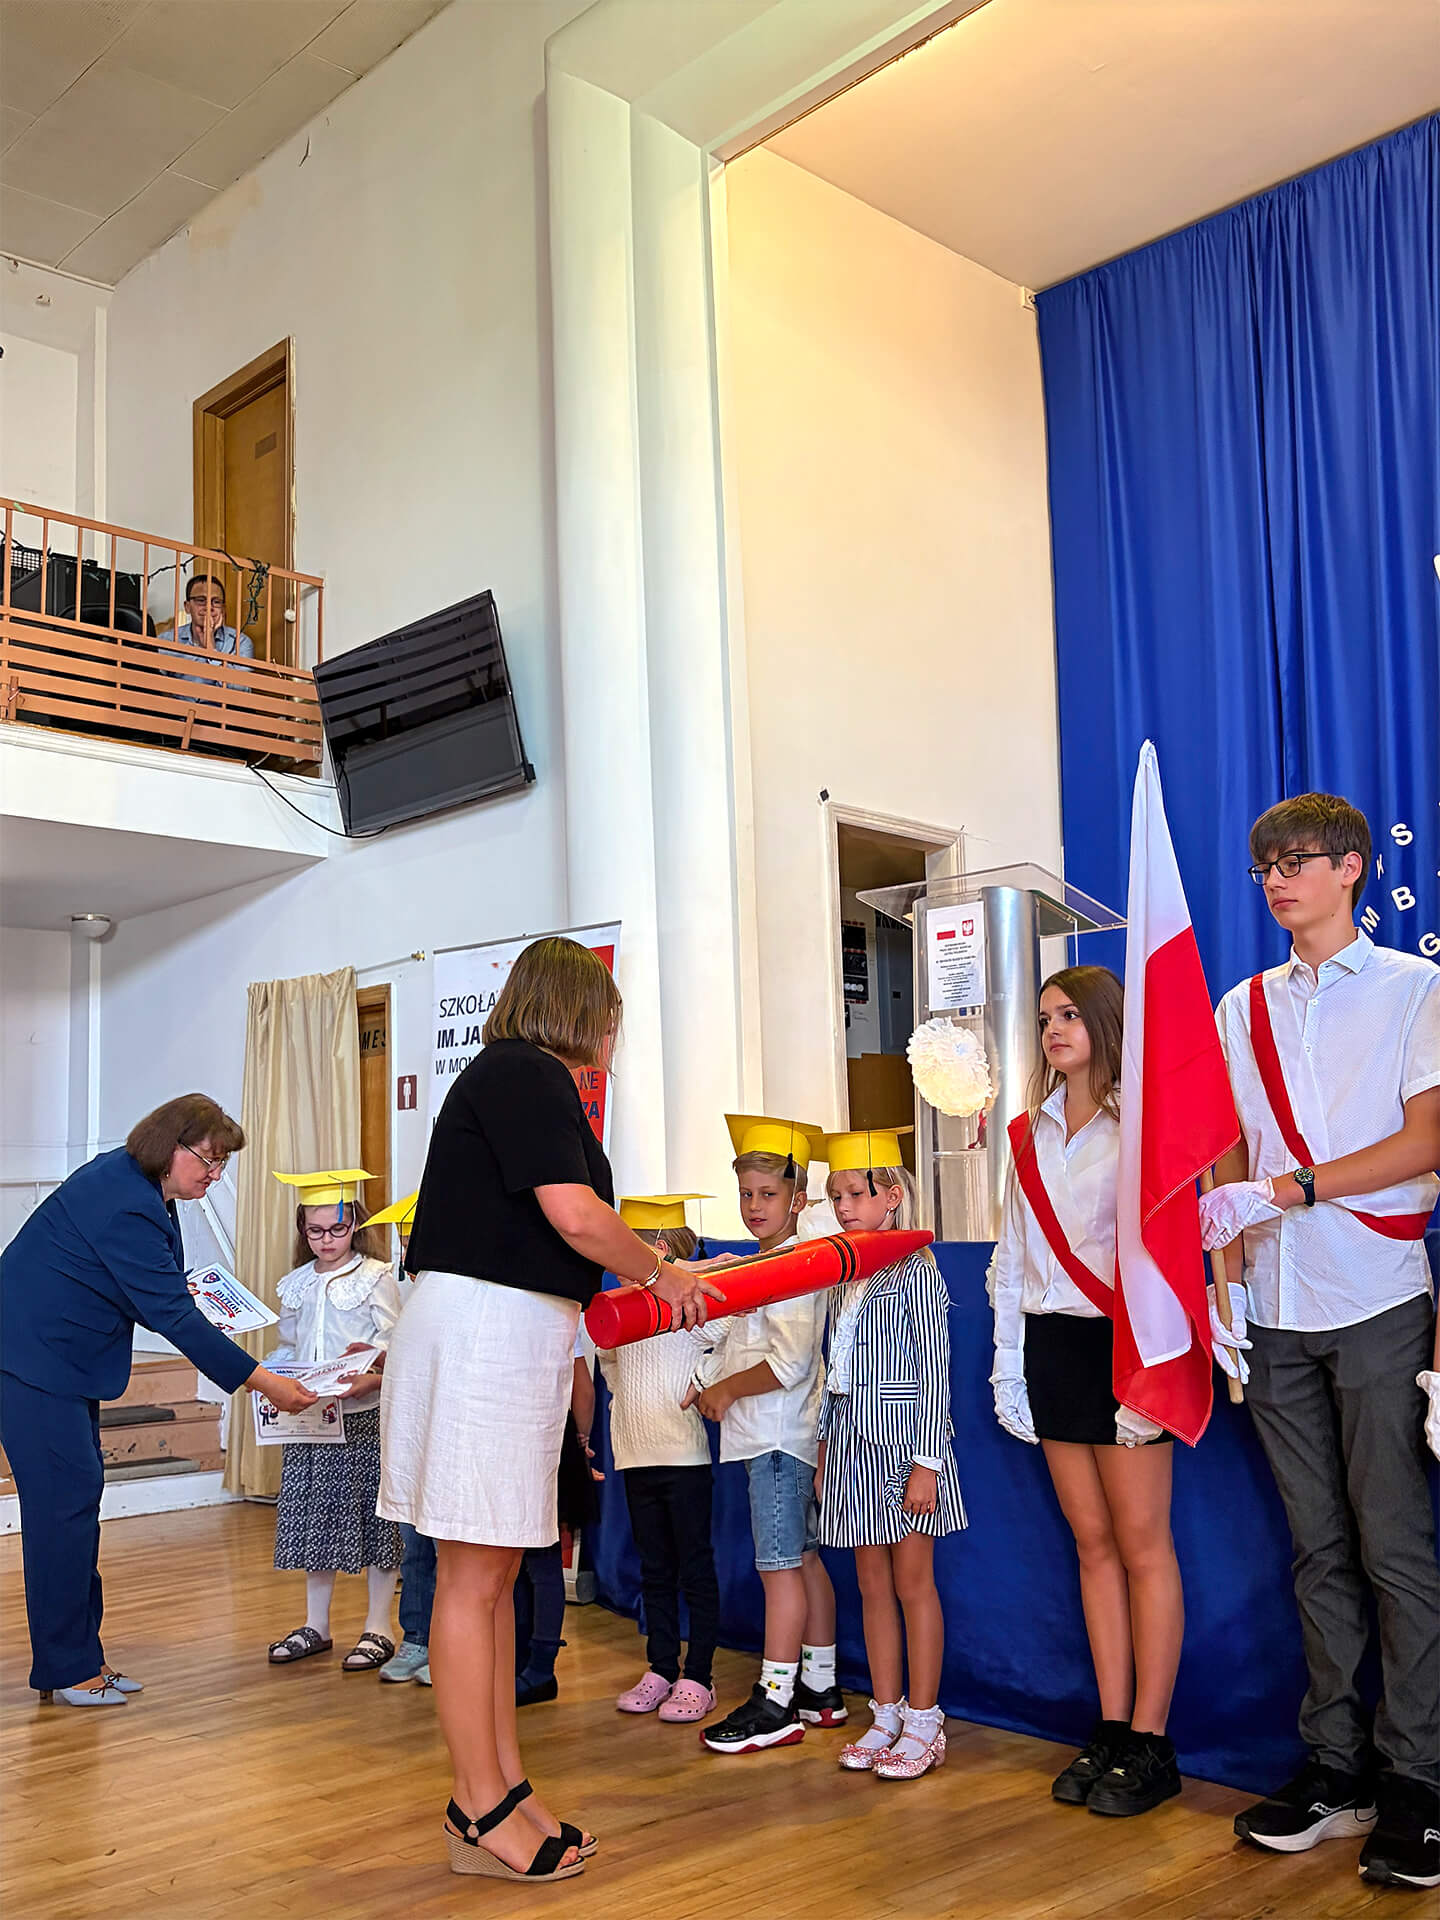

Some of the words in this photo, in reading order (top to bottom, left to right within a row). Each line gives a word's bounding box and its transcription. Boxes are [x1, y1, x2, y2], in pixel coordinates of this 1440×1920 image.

[439, 991, 497, 1018] SZKOŁA
[437, 1028, 459, 1049] IM.
[461, 1024, 486, 1046] JA
[435, 1059, 446, 1076] W
